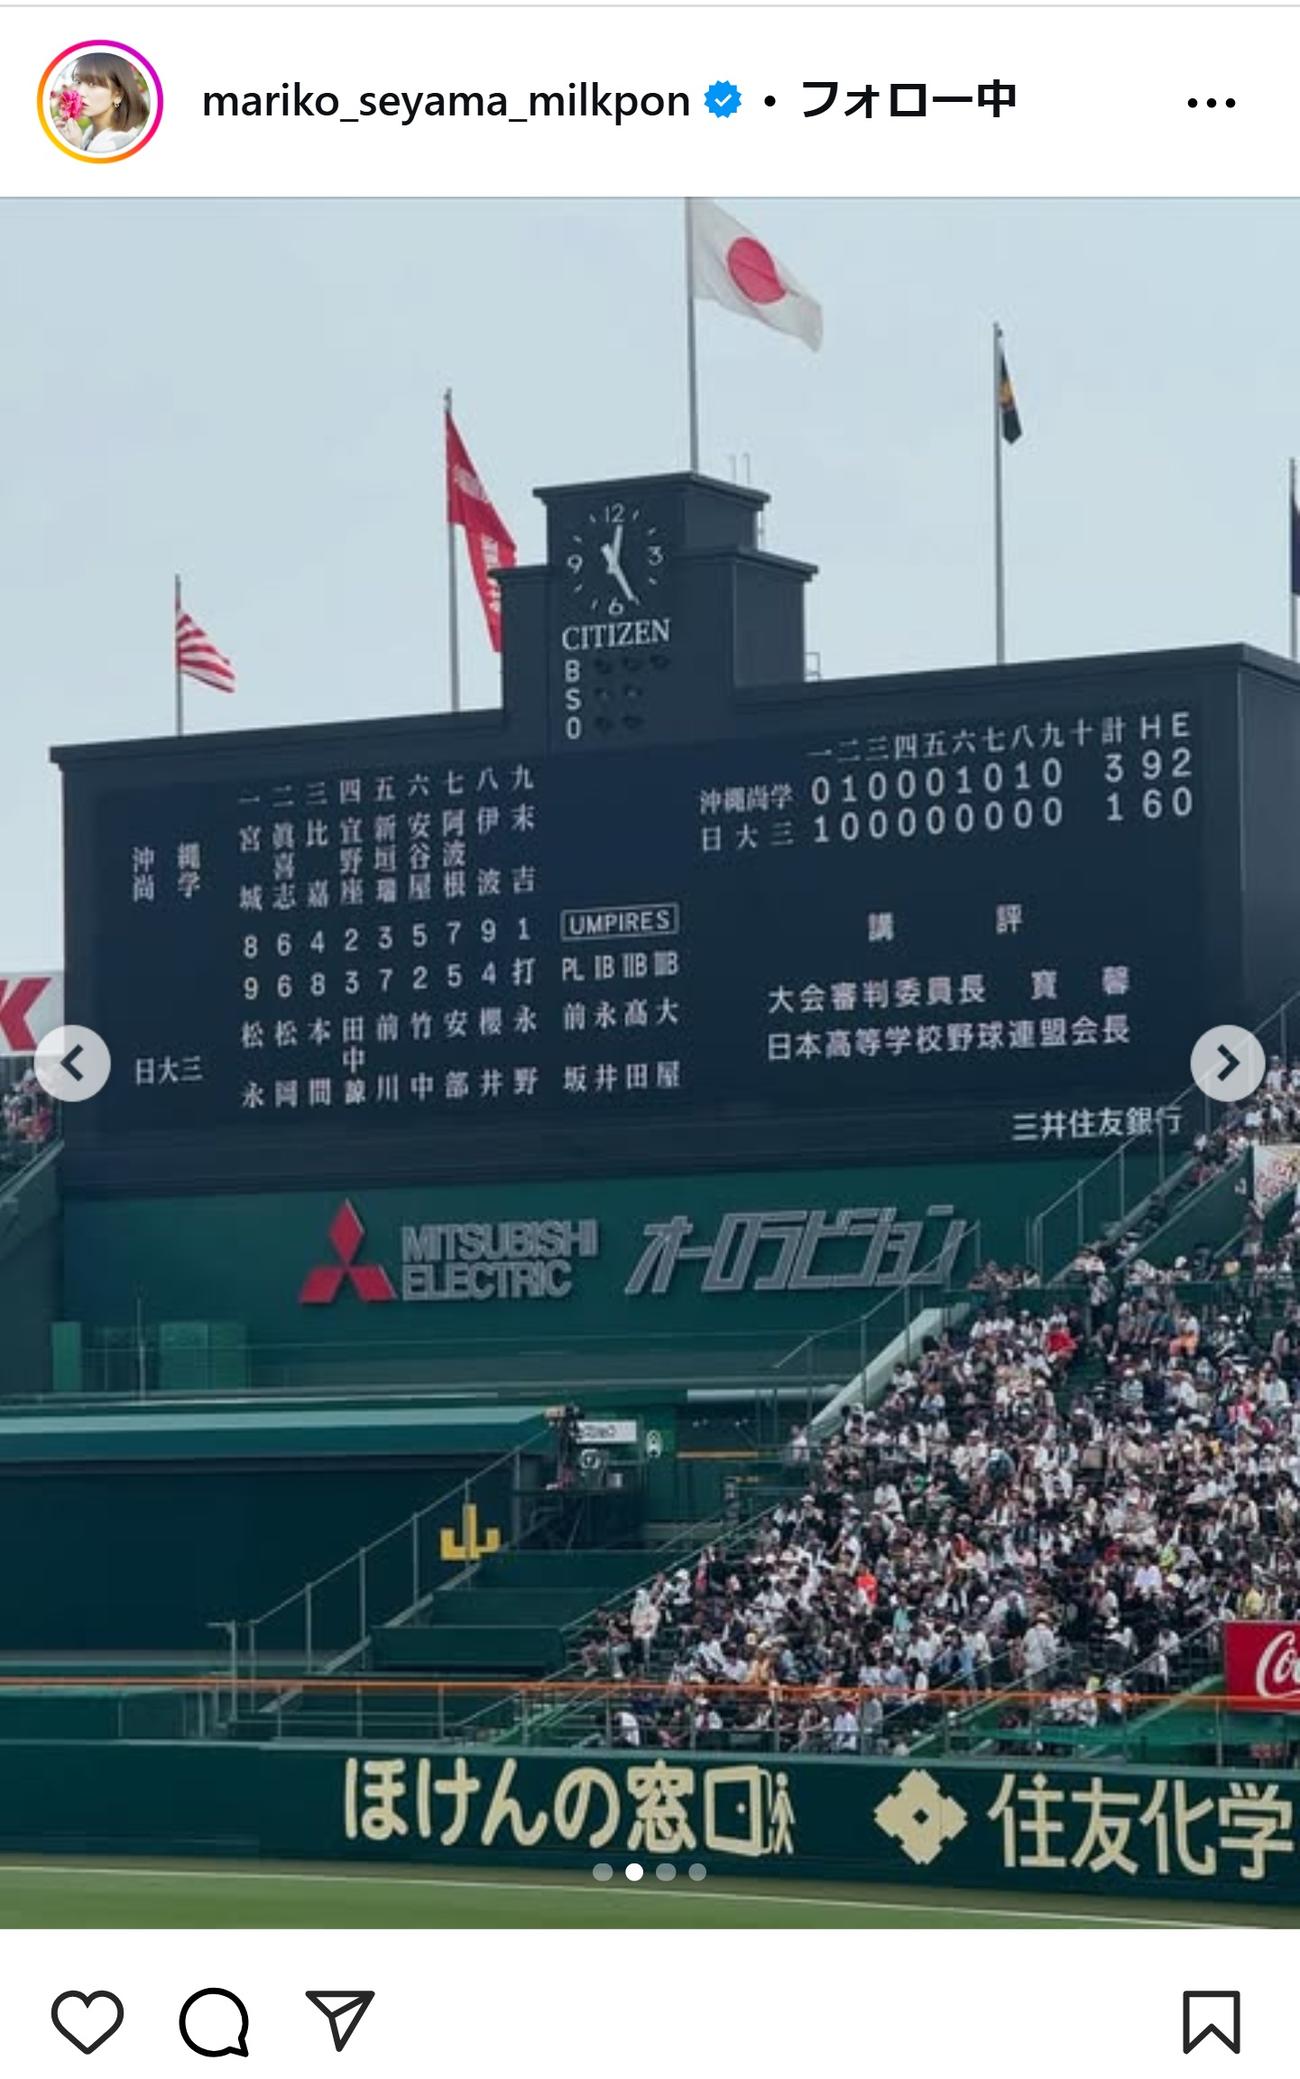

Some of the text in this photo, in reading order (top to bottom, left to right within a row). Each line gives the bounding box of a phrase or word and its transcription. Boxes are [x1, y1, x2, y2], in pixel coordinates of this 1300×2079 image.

[604, 502, 625, 526] 12
[566, 554, 583, 574] 9
[648, 545, 664, 566] 3
[607, 597, 624, 616] 6
[561, 618, 670, 651] CITIZEN
[564, 659, 581, 683] B
[565, 687, 582, 711] S
[1140, 714, 1161, 740] H
[1172, 711, 1190, 738] E
[700, 783, 793, 815] 沖縄尚学
[567, 909, 673, 935] UMPIRES
[767, 974, 987, 1015] 大会審判委員長
[767, 1014, 1131, 1061] 日本高等学校野球連盟会長
[135, 1055, 203, 1086] 日大三
[1011, 1106, 1183, 1141] 三井住友銀行
[402, 1218, 598, 1262] MITSUBISHI
[402, 1258, 574, 1301] ELECTRIC
[990, 1772, 1295, 1881] 住友化学
